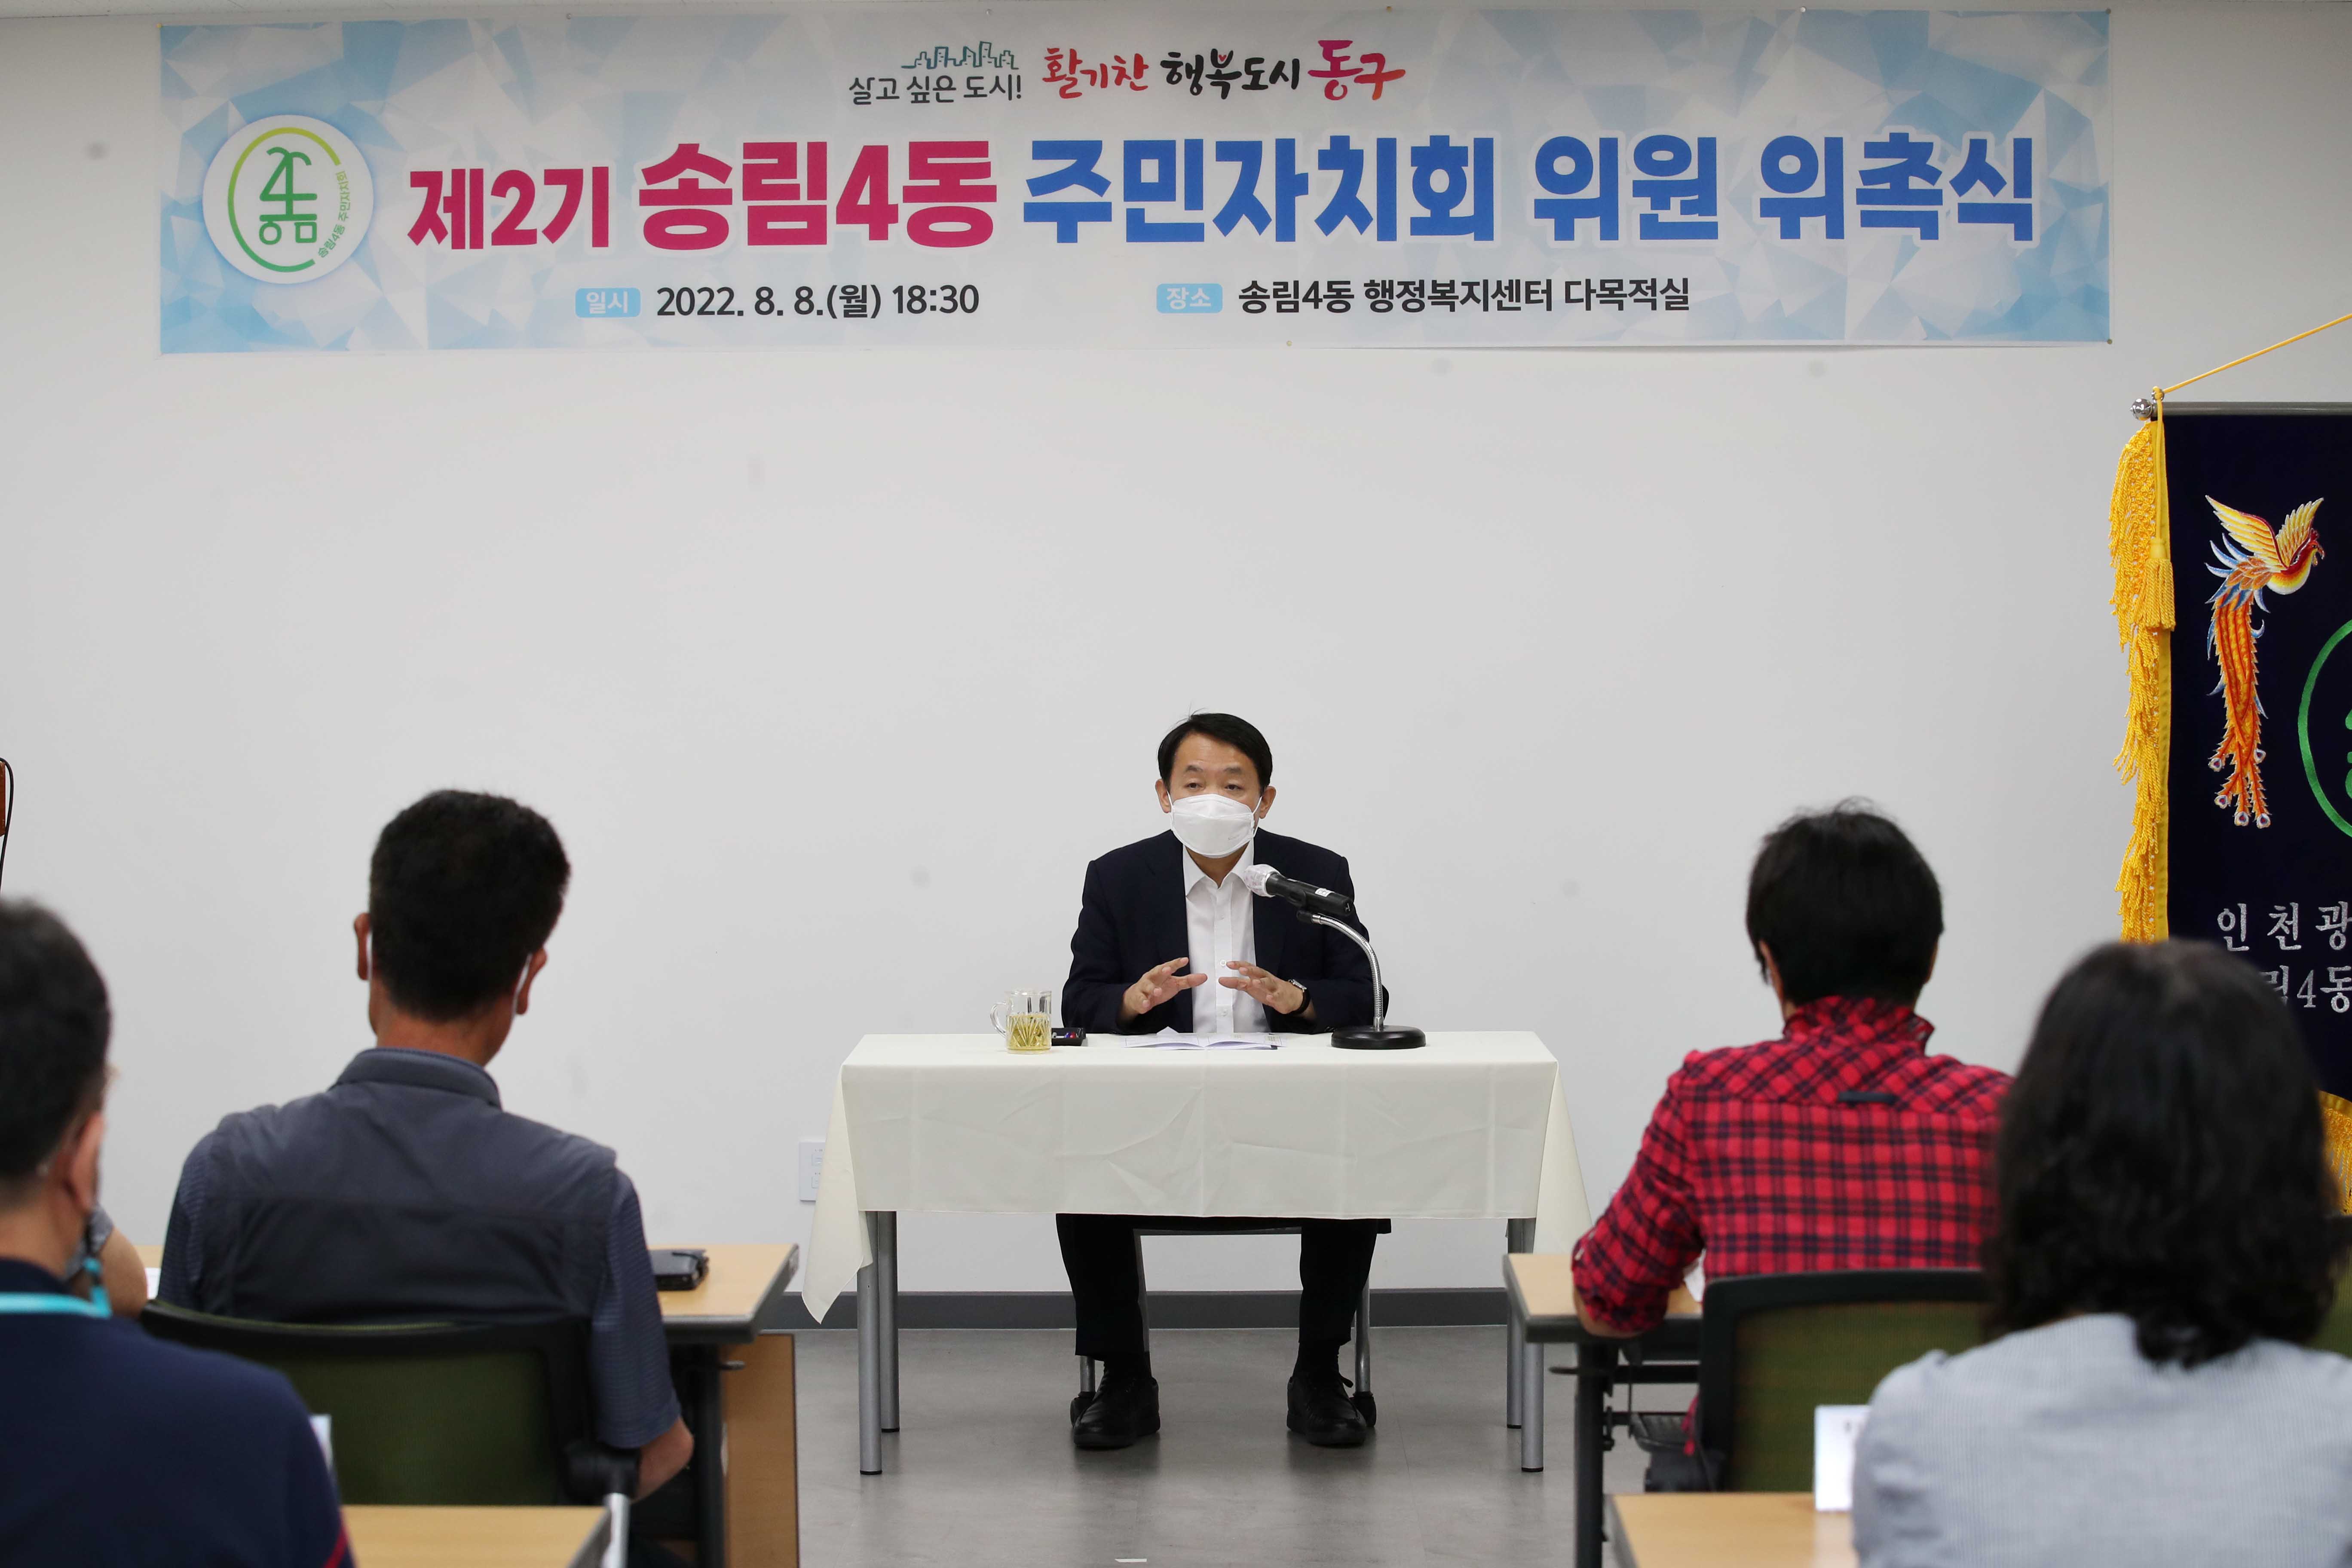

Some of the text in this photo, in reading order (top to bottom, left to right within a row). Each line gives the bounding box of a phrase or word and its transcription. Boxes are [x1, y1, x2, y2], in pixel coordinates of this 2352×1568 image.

[1042, 40, 1406, 101] 활기찬 행복도시 동구
[848, 74, 1022, 106] 살고 싶은 도시!
[407, 166, 609, 250] 제2기
[639, 141, 997, 251] 송림4동
[1024, 135, 1494, 243] 주민자치회
[1534, 135, 1718, 241] 위원
[1760, 132, 2033, 241] 위촉식
[586, 291, 628, 314] 일시
[657, 286, 744, 317] 2022.
[892, 284, 980, 315] 18:30
[1166, 287, 1212, 310] 장소
[1238, 277, 1690, 314] 송림4동 행정복지센터 다목적실
